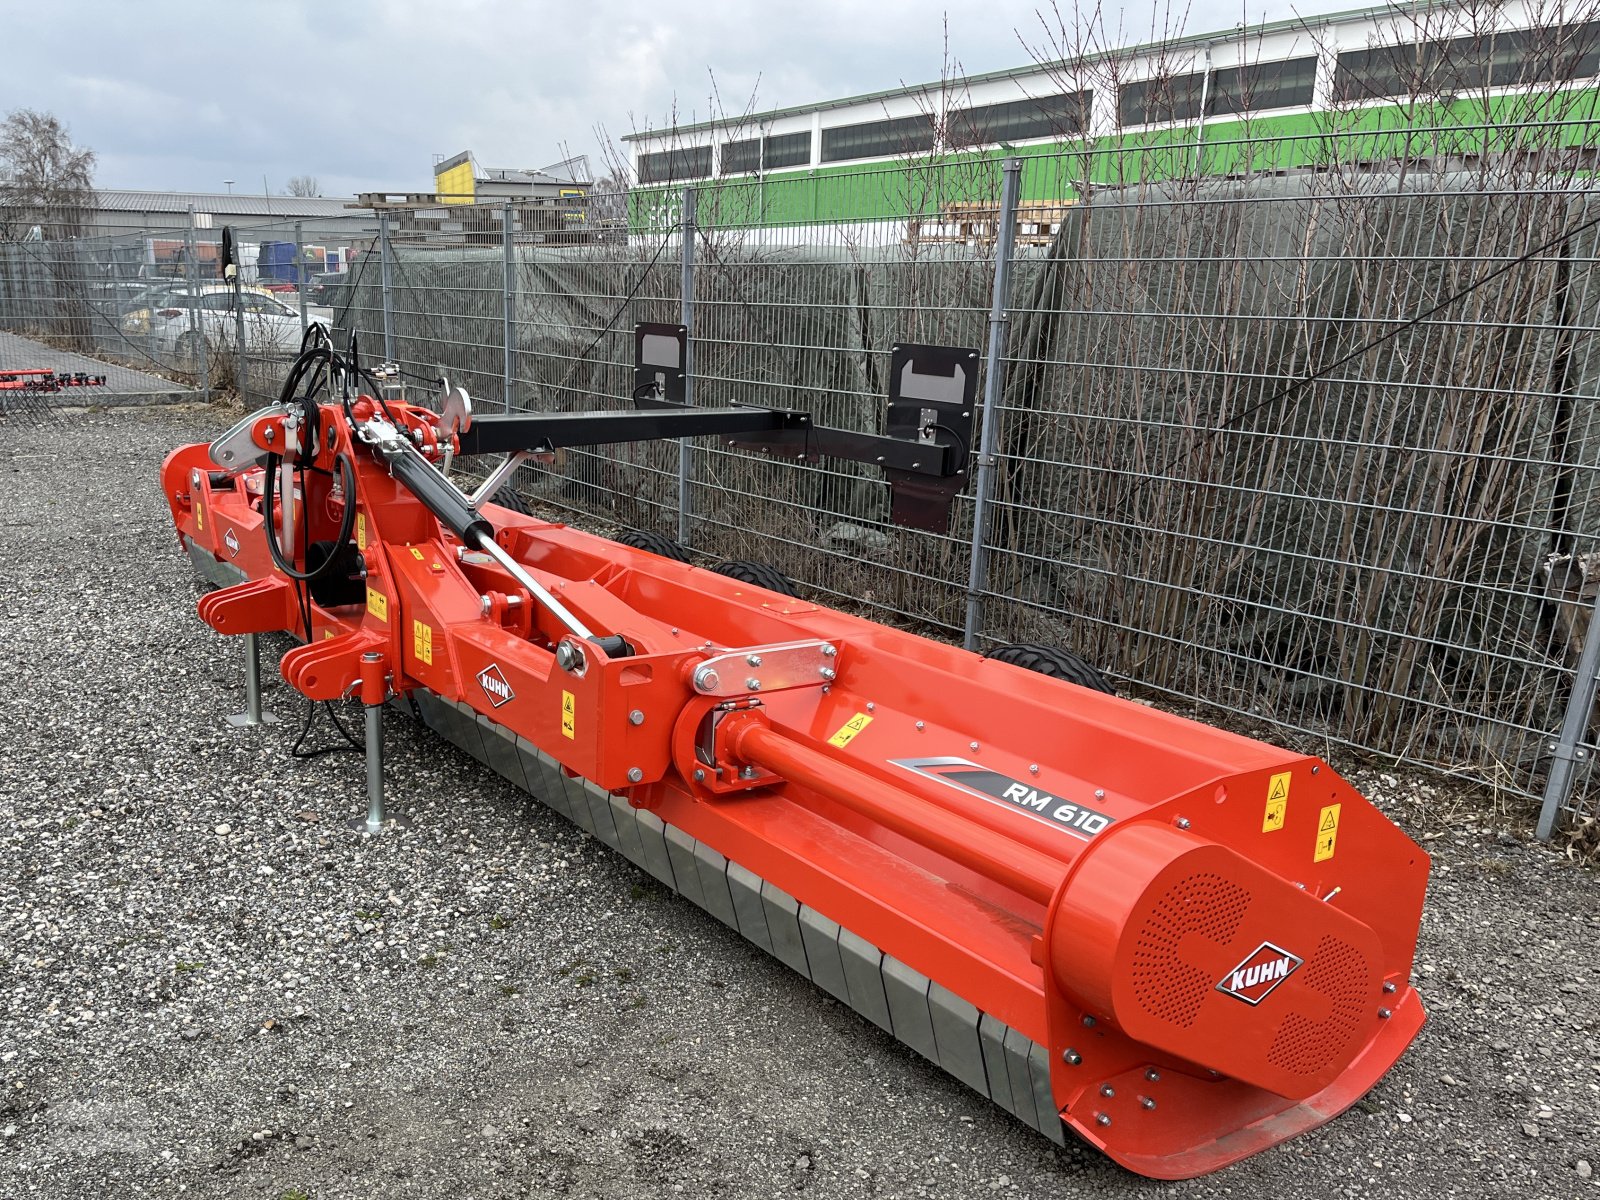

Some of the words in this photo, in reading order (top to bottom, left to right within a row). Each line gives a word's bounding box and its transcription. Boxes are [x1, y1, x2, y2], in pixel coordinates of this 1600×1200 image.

[482, 673, 508, 699] KUHN
[1002, 782, 1053, 812] RM
[1053, 804, 1109, 834] 610
[1230, 957, 1290, 992] KUHN
